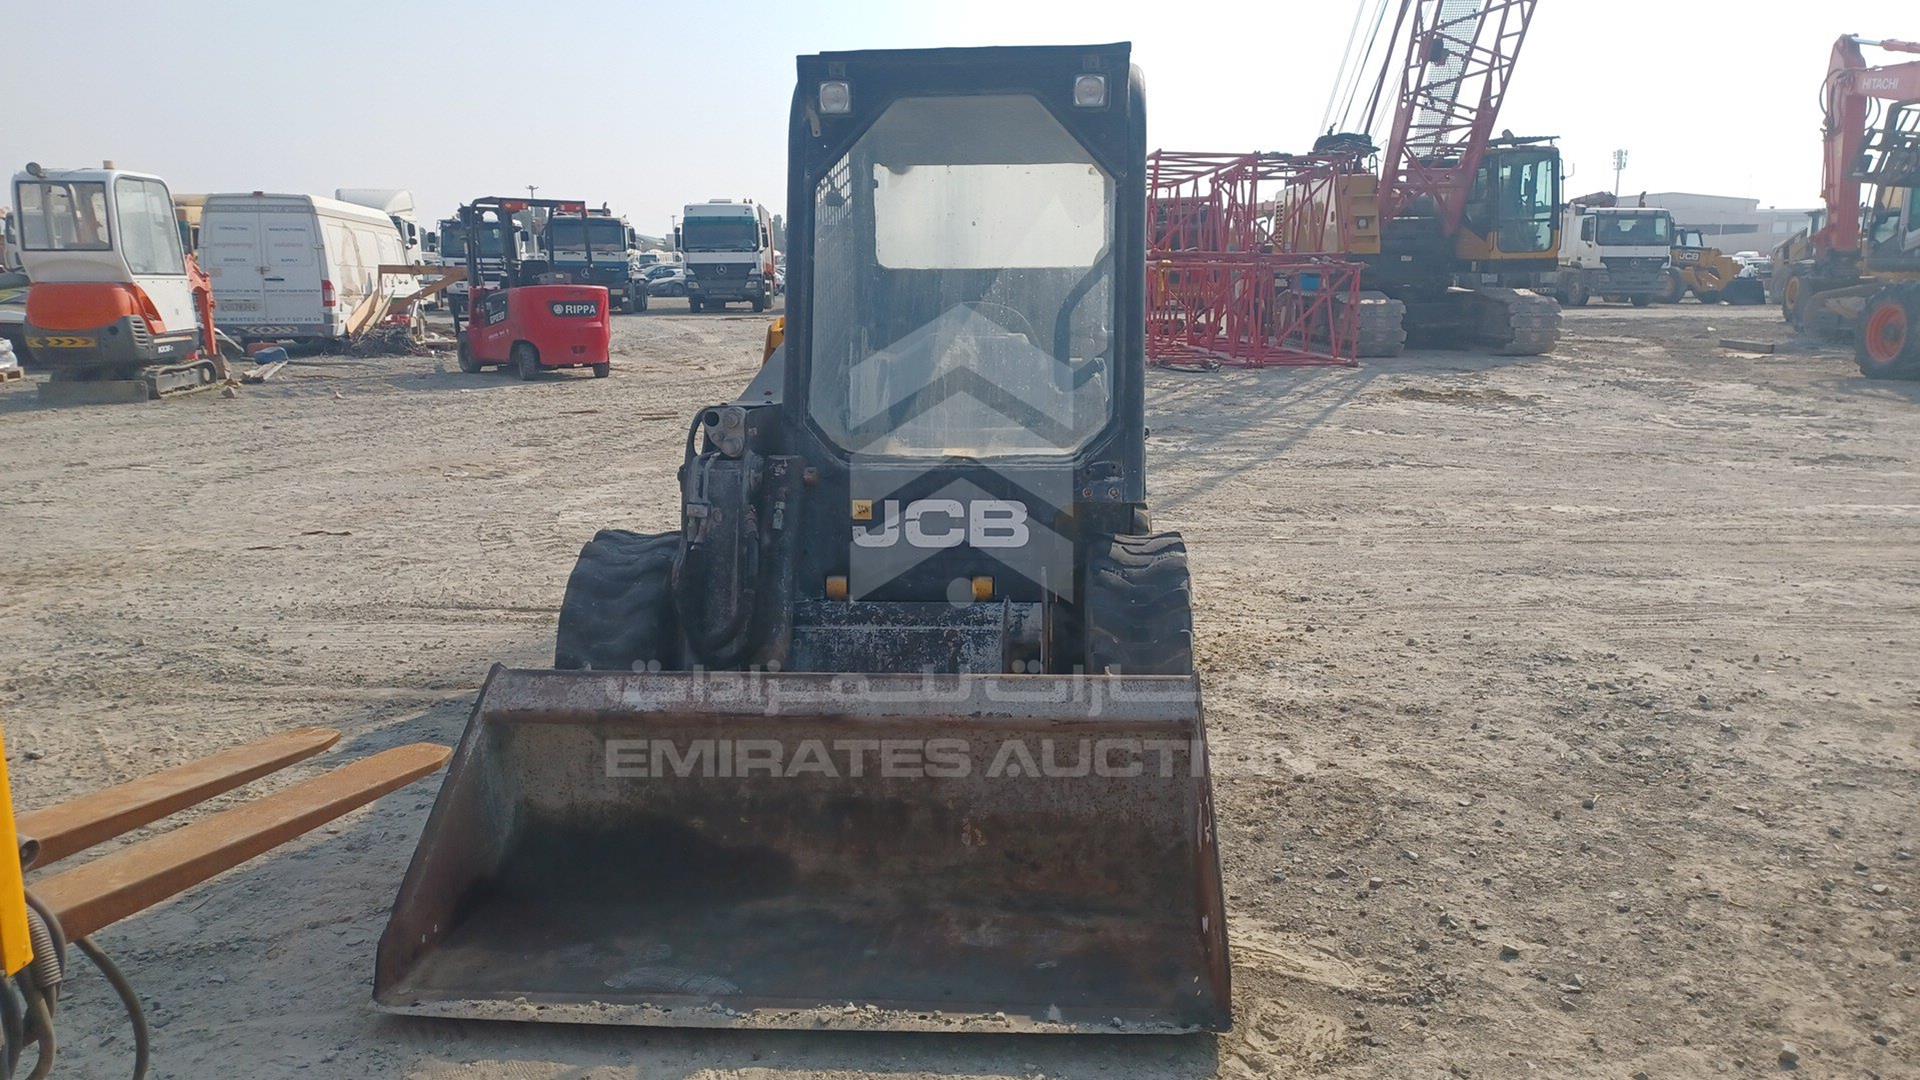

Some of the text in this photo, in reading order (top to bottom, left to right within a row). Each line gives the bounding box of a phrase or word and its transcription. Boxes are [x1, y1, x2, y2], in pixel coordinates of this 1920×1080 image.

[1862, 78, 1900, 90] HITACHI
[1679, 252, 1699, 260] JCB
[565, 304, 597, 315] RIPPA
[852, 499, 1030, 548] JCB
